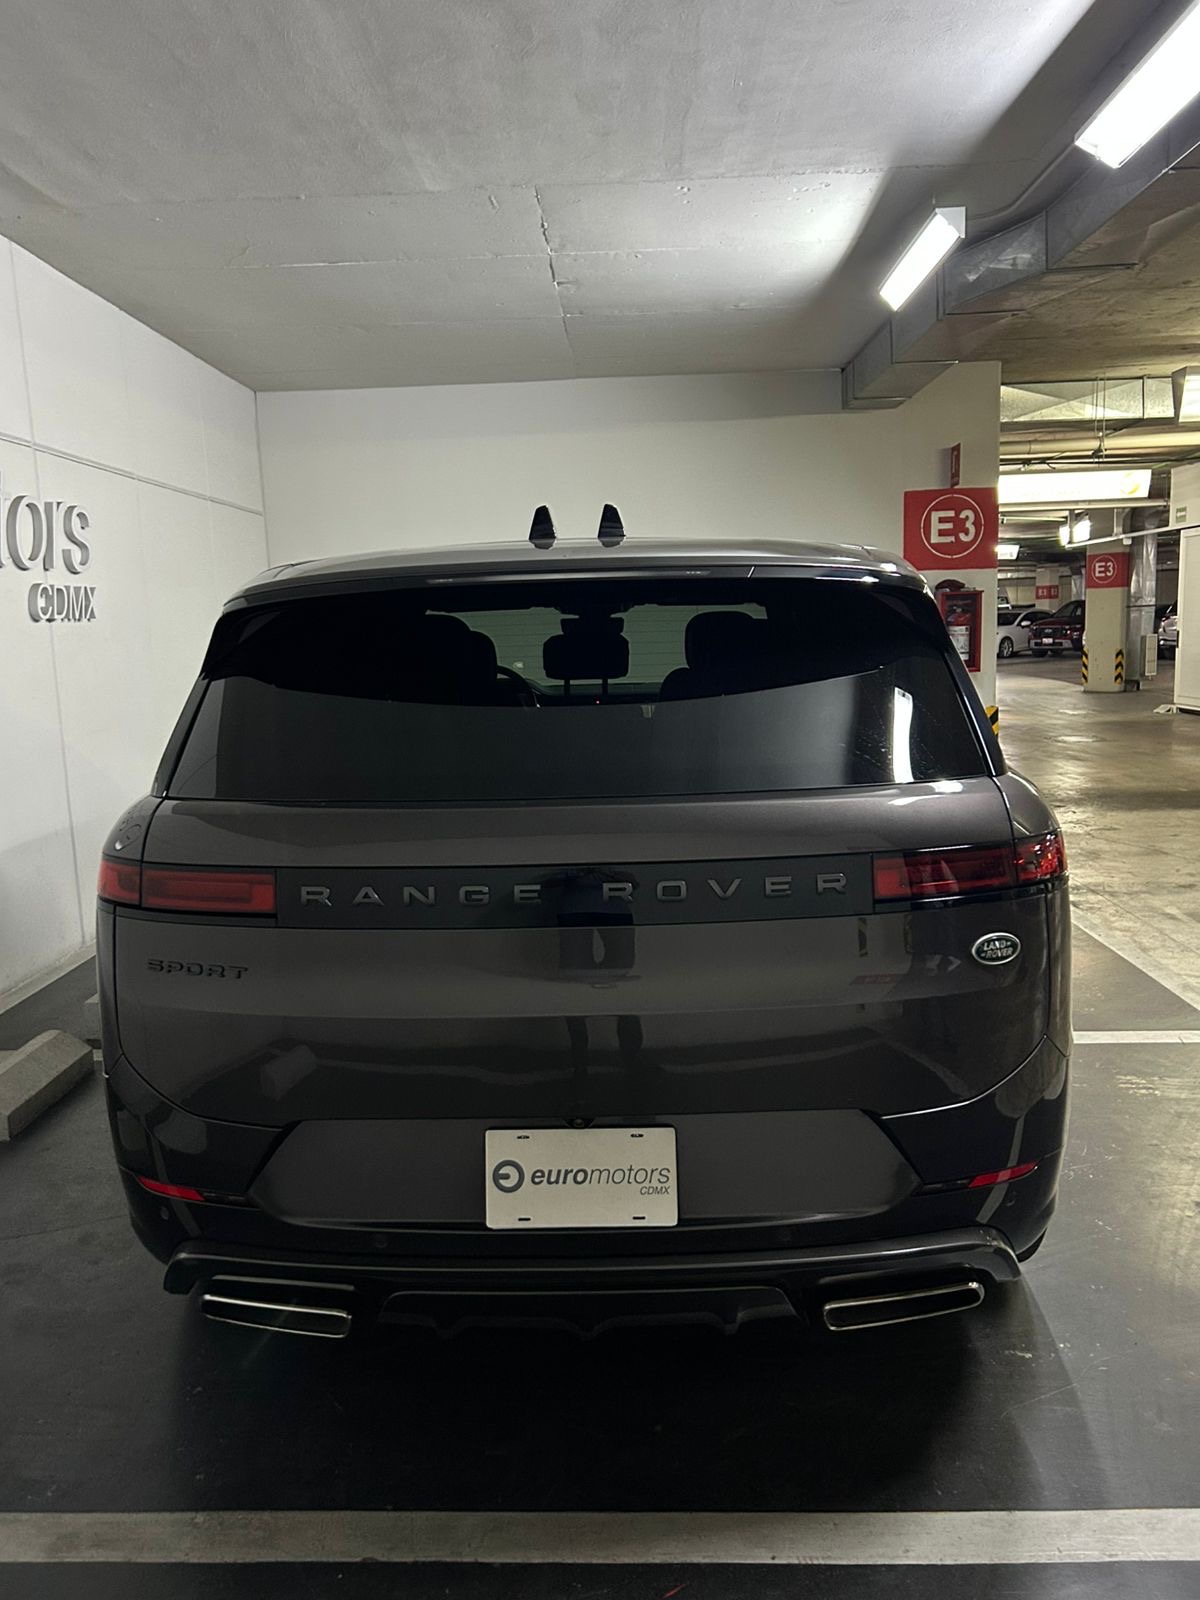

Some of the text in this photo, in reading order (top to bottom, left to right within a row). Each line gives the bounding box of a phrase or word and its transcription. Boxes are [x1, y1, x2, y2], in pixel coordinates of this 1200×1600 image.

[0, 493, 92, 575] ors
[930, 509, 976, 544] E3
[1095, 561, 1114, 577] E3
[28, 582, 97, 623] CDMX
[300, 873, 847, 907] RANGE ROVER
[983, 940, 1006, 951] LAND
[985, 947, 1013, 958] ROVER
[147, 958, 248, 979] SPORT
[530, 1164, 671, 1185] euromotors
[639, 1185, 670, 1195] CDMX
